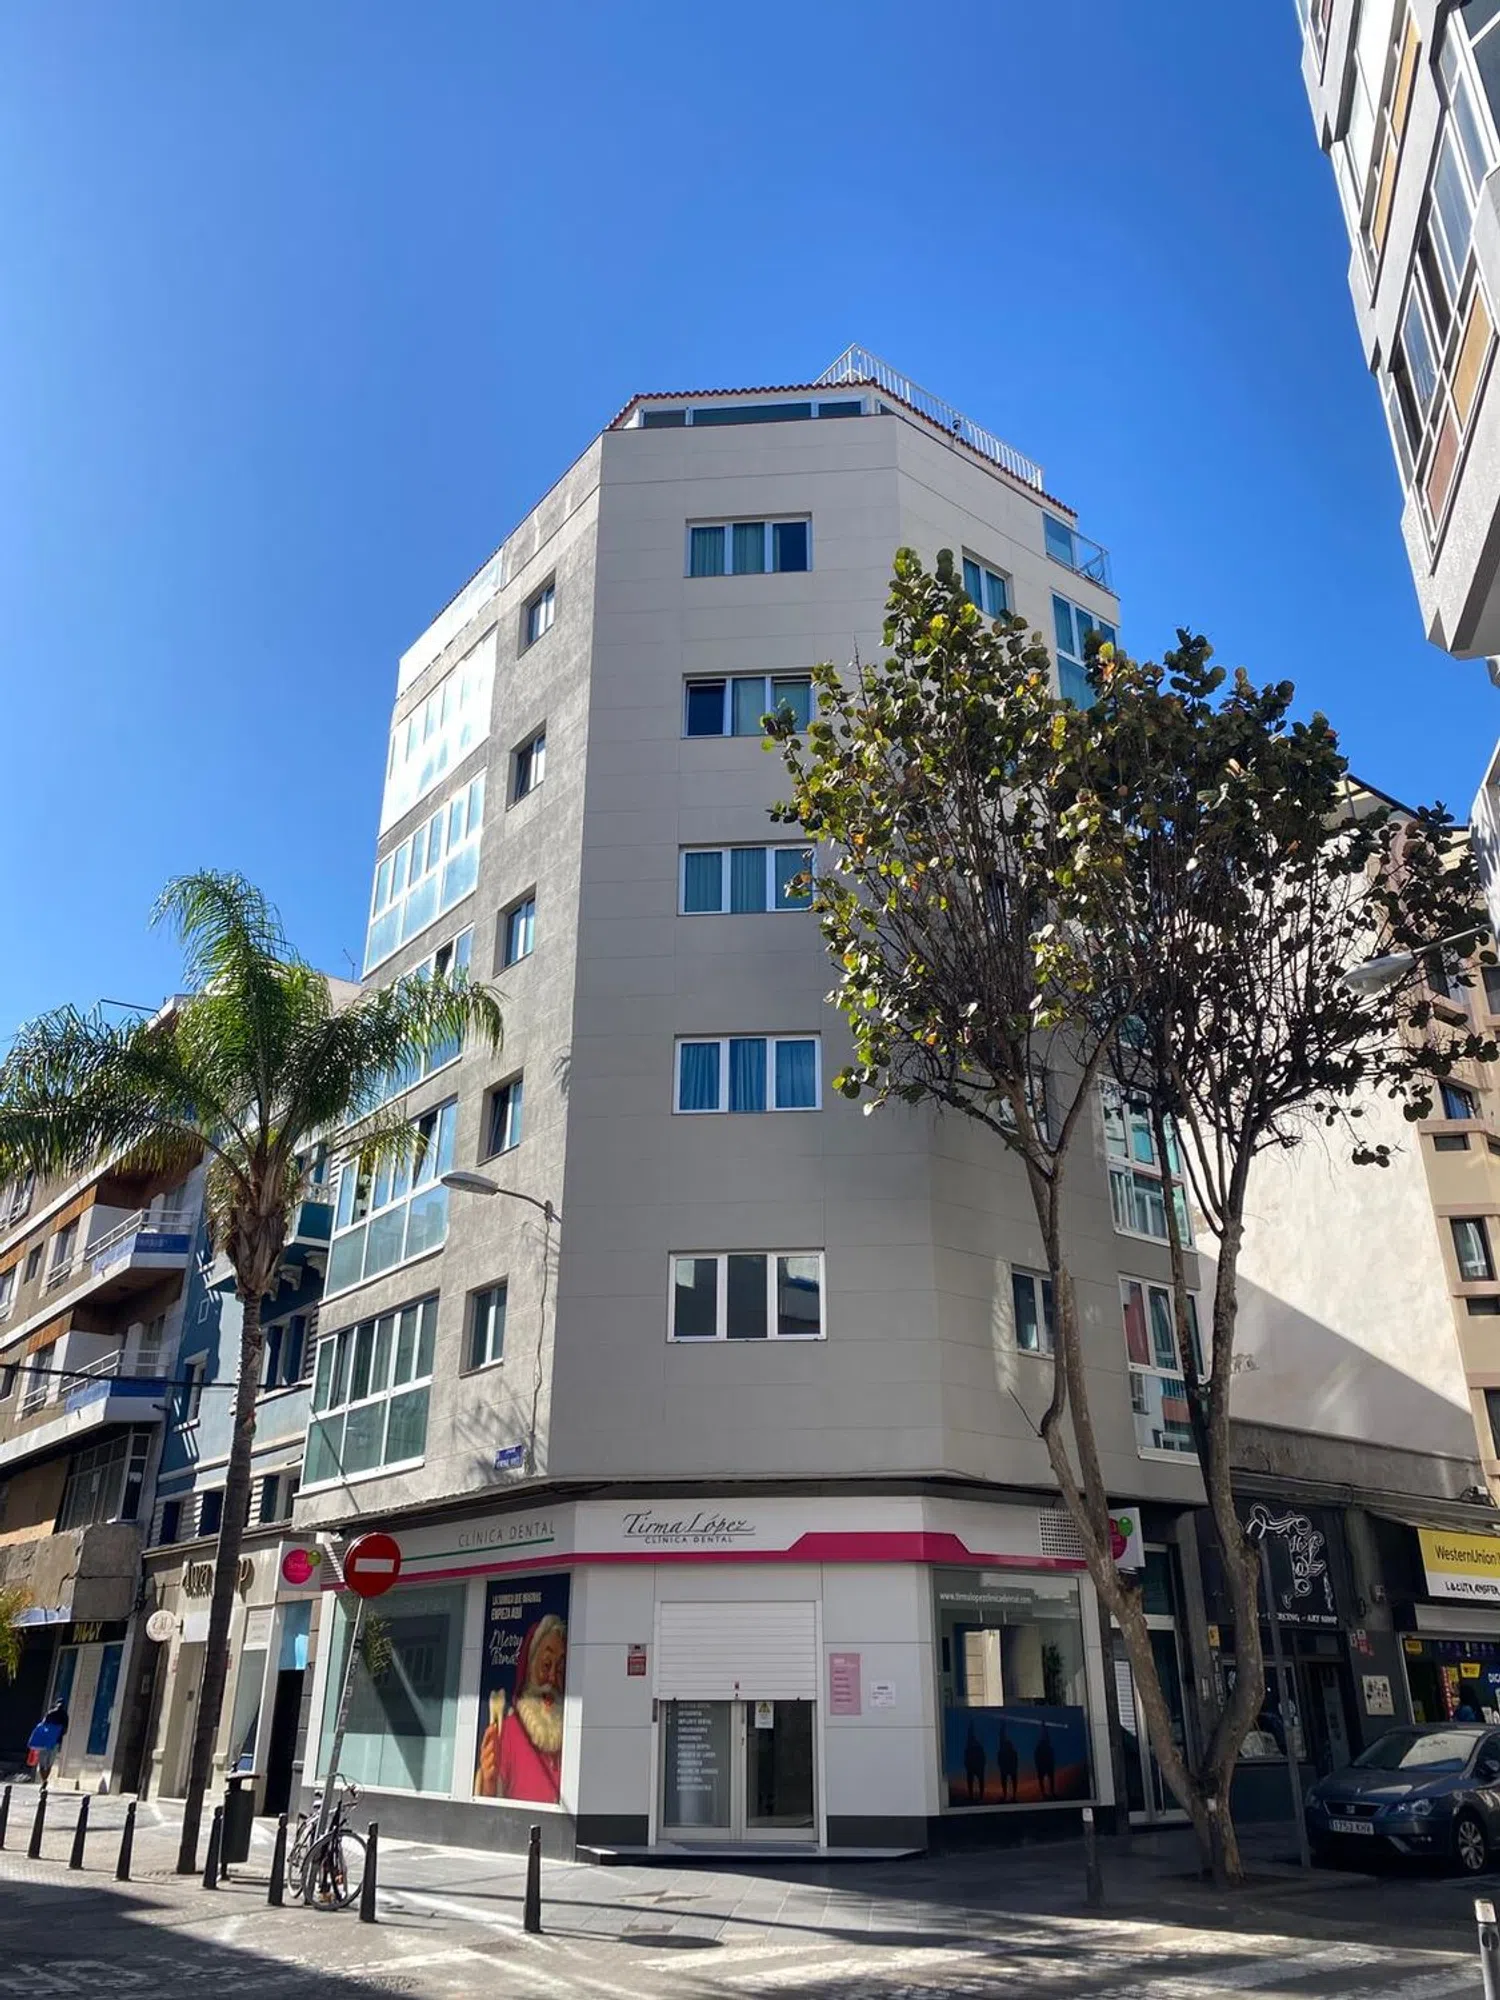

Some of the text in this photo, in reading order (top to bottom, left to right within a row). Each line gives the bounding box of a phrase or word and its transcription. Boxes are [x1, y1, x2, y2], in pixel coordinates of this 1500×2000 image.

[509, 1520, 555, 1540] DENTAL
[623, 1511, 756, 1536] Tirma López
[693, 1534, 733, 1544] DENTAL
